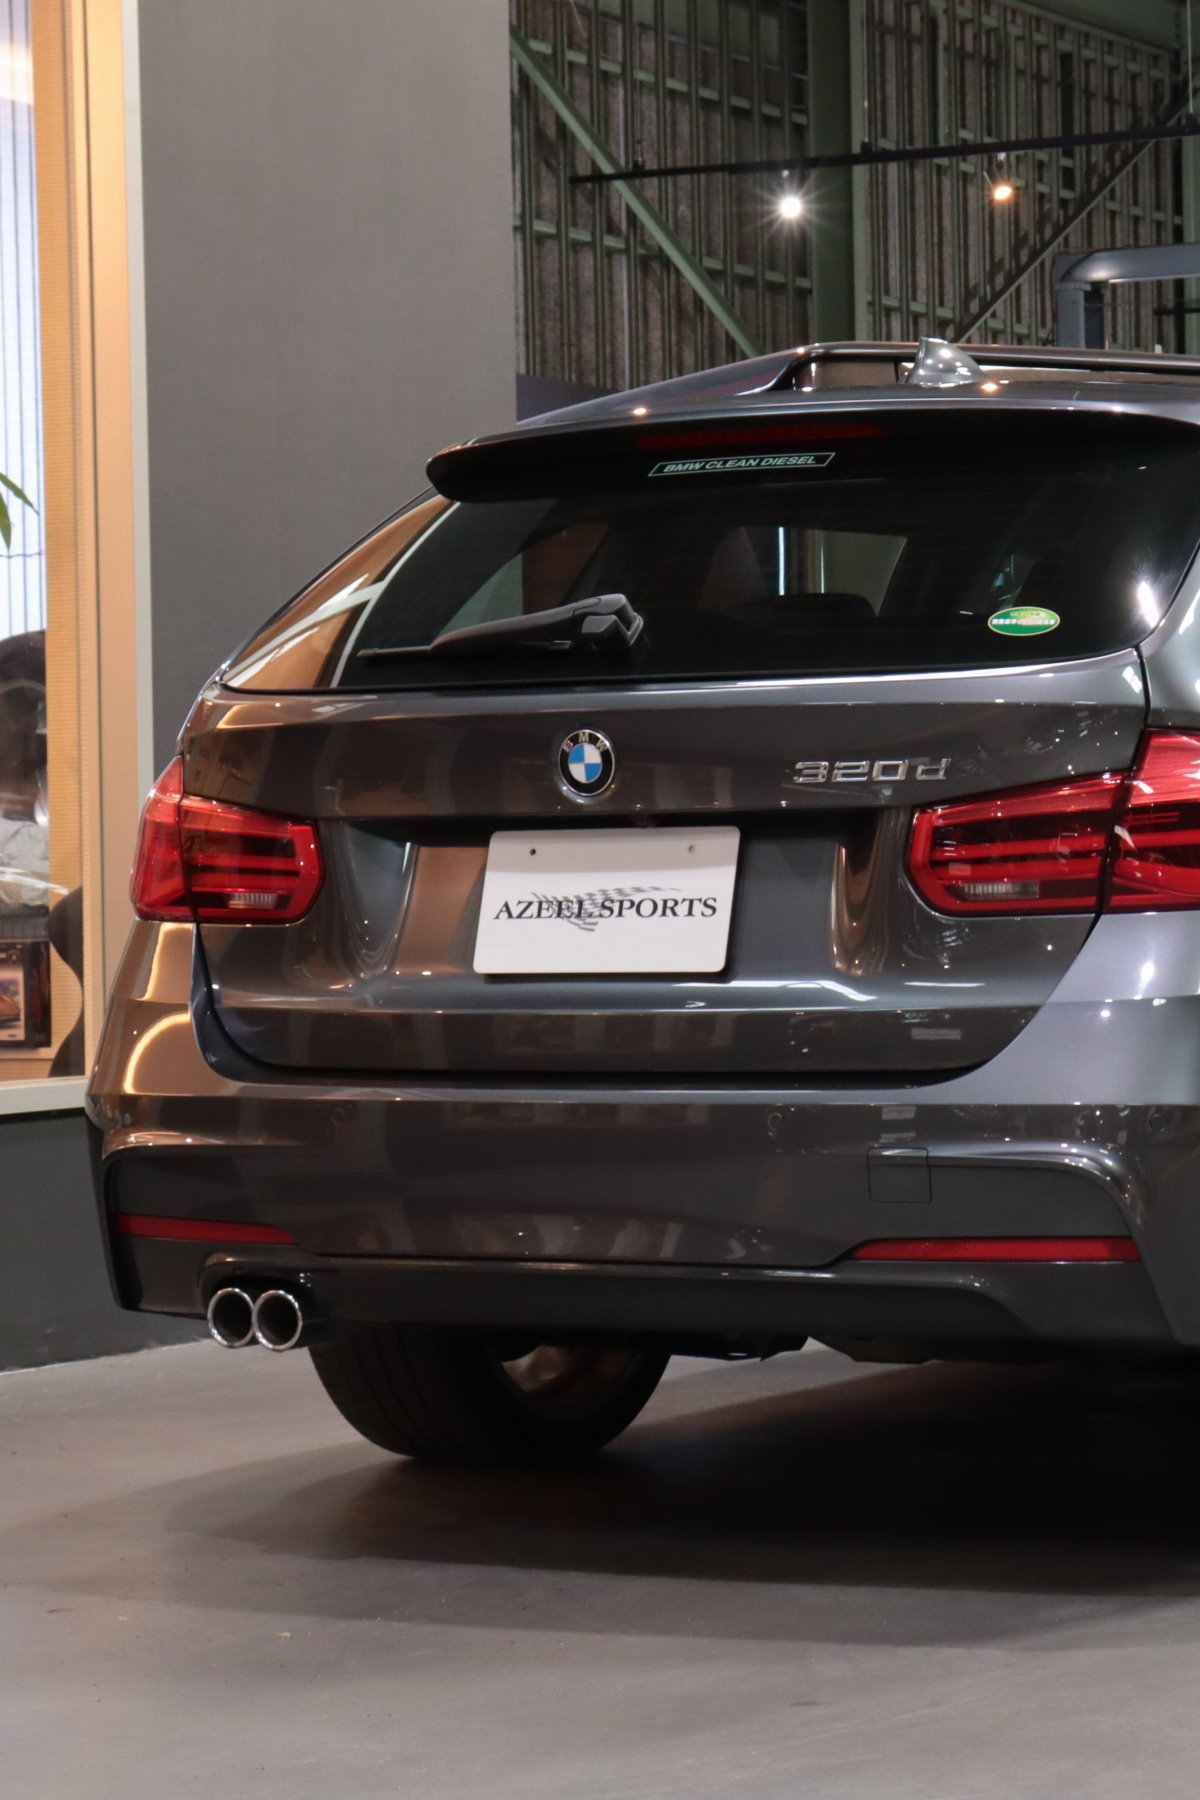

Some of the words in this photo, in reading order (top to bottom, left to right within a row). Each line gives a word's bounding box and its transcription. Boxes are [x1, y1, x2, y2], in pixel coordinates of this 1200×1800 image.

[663, 462, 704, 473] BMW
[705, 458, 759, 470] CLEAN
[760, 455, 817, 467] DIESEL
[562, 731, 609, 753] BMW
[493, 899, 597, 920] AZEEL
[598, 897, 718, 919] SPORTS
